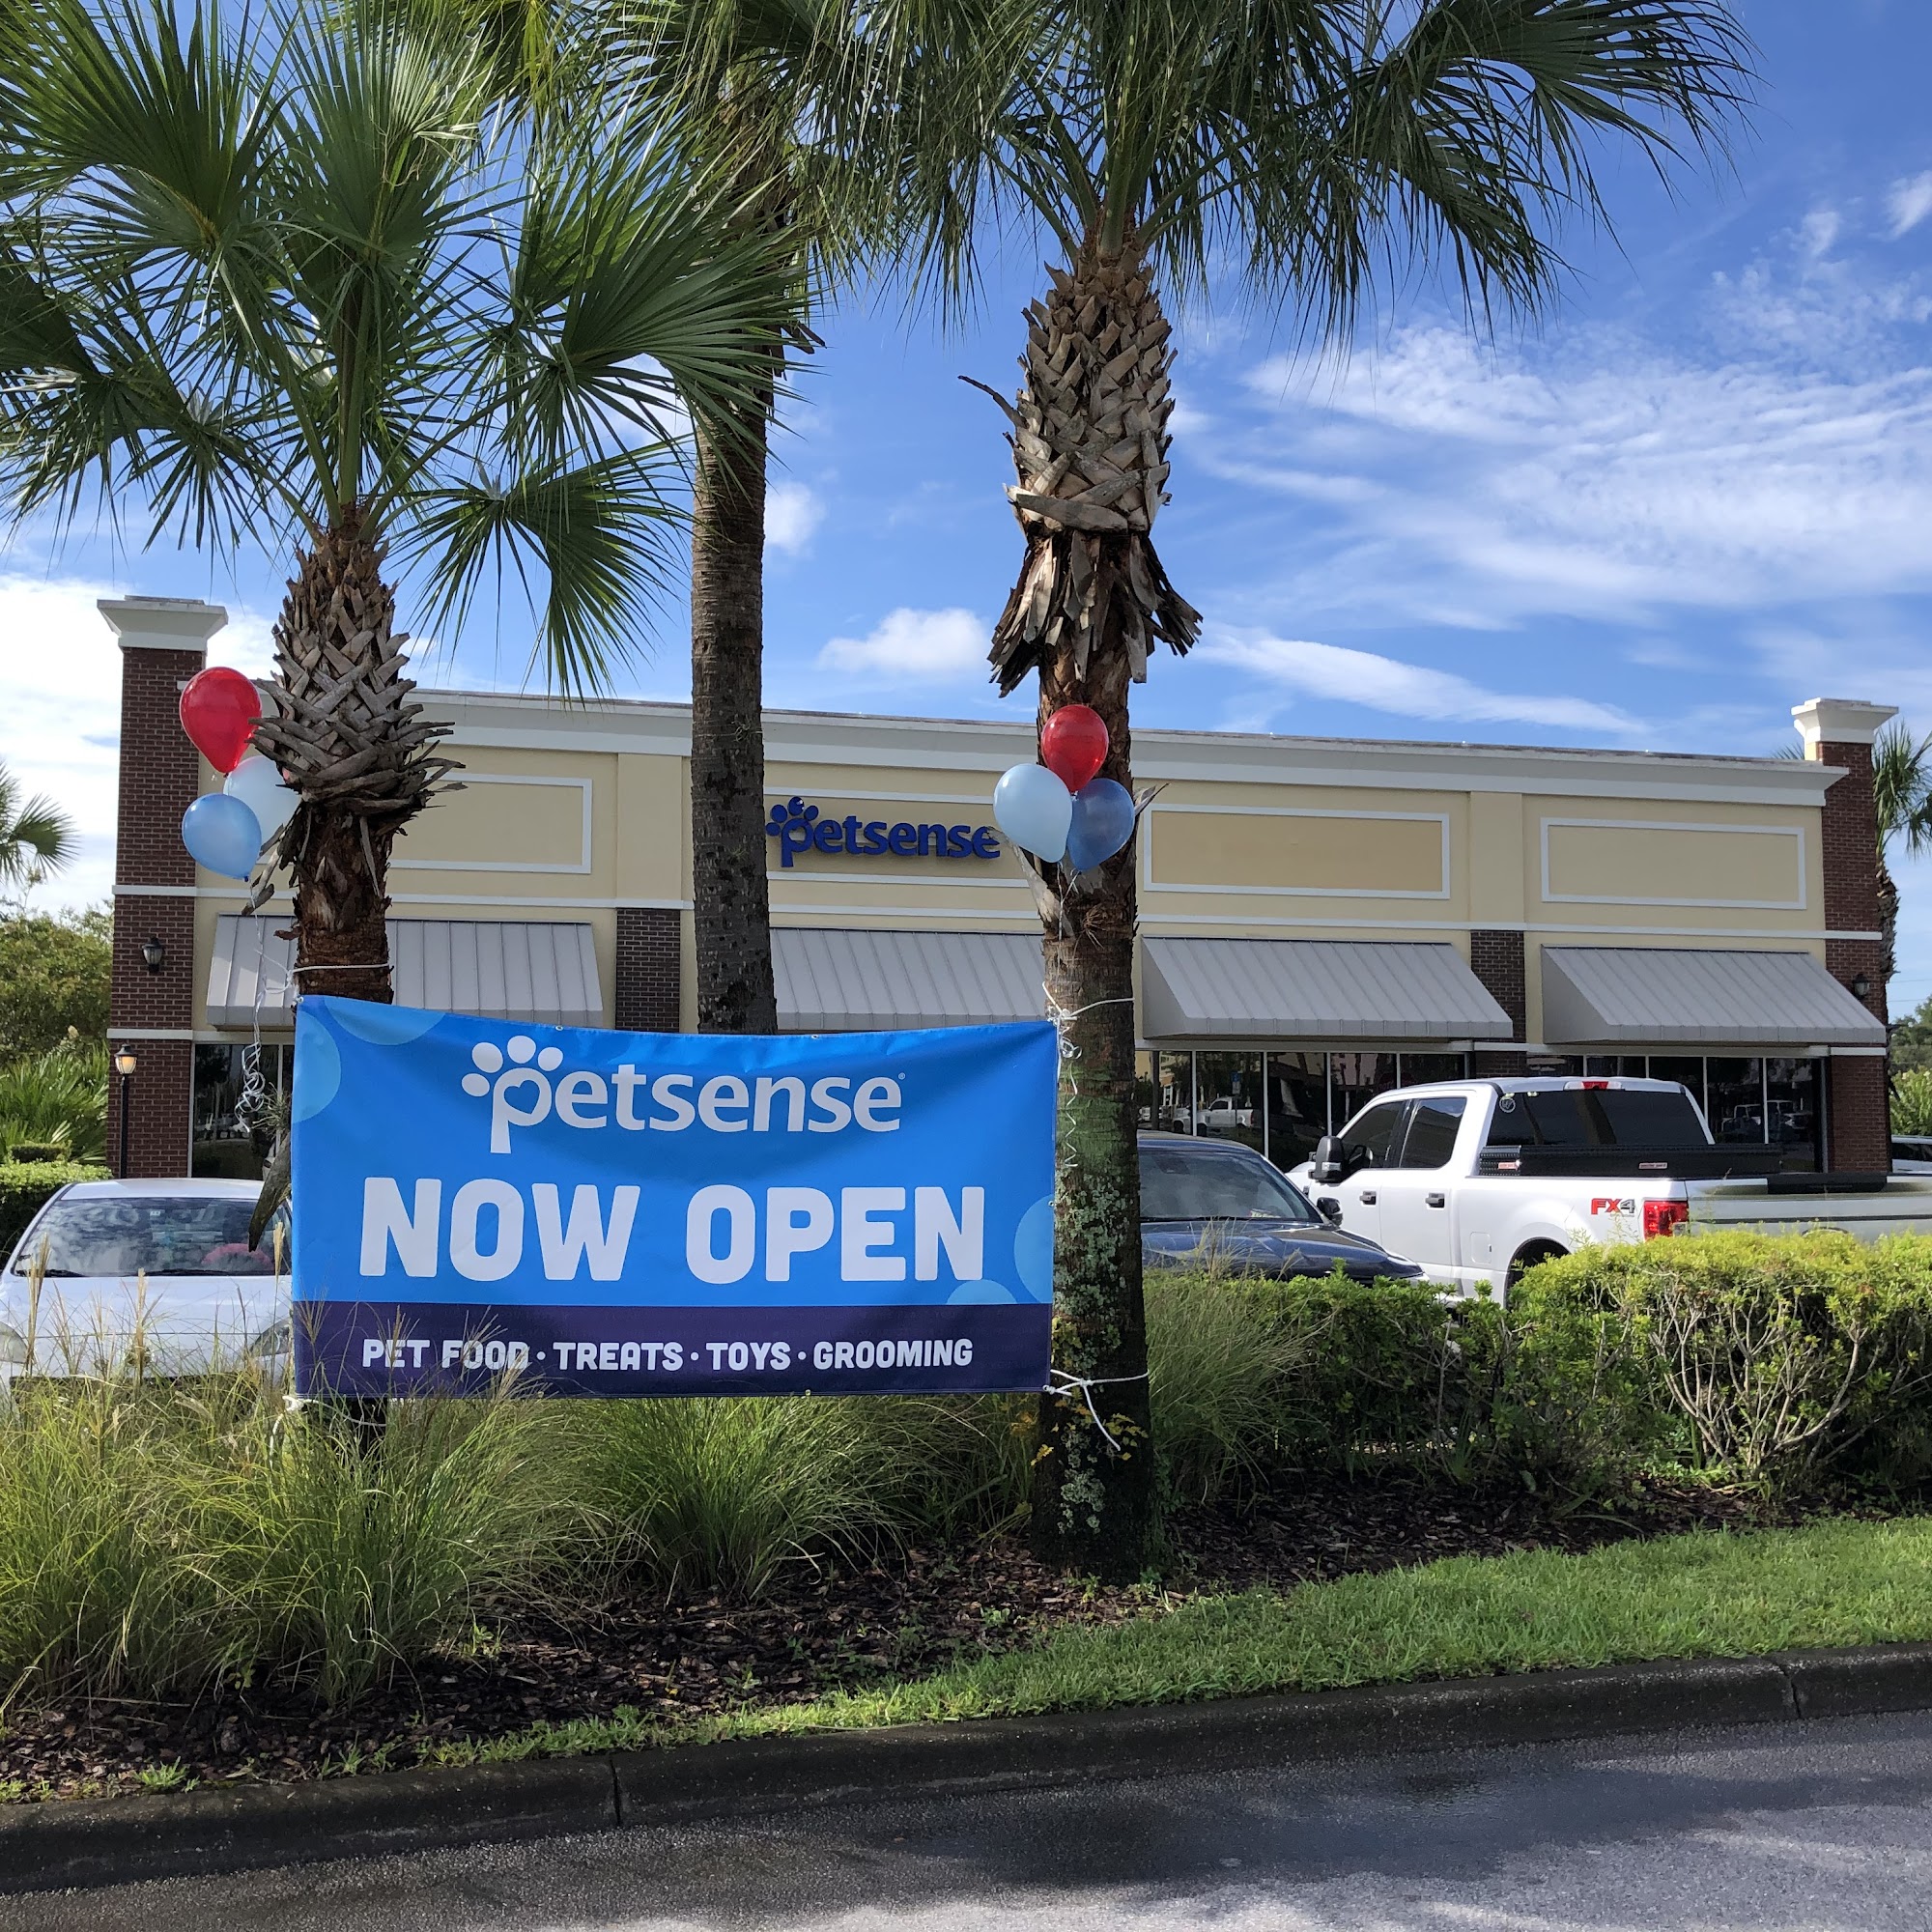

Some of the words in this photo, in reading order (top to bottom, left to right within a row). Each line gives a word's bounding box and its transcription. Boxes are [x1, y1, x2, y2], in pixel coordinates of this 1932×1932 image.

[781, 814, 1001, 867] petsense
[489, 1064, 903, 1154] petsense
[358, 1176, 640, 1282] NOW
[686, 1183, 985, 1284] OPEN
[1590, 1197, 1635, 1215] FX4
[362, 1338, 431, 1369] PET
[441, 1339, 530, 1370] FOOD
[553, 1341, 684, 1371] TREATS
[705, 1341, 791, 1371] TOYS
[813, 1338, 974, 1371] GROOMING
